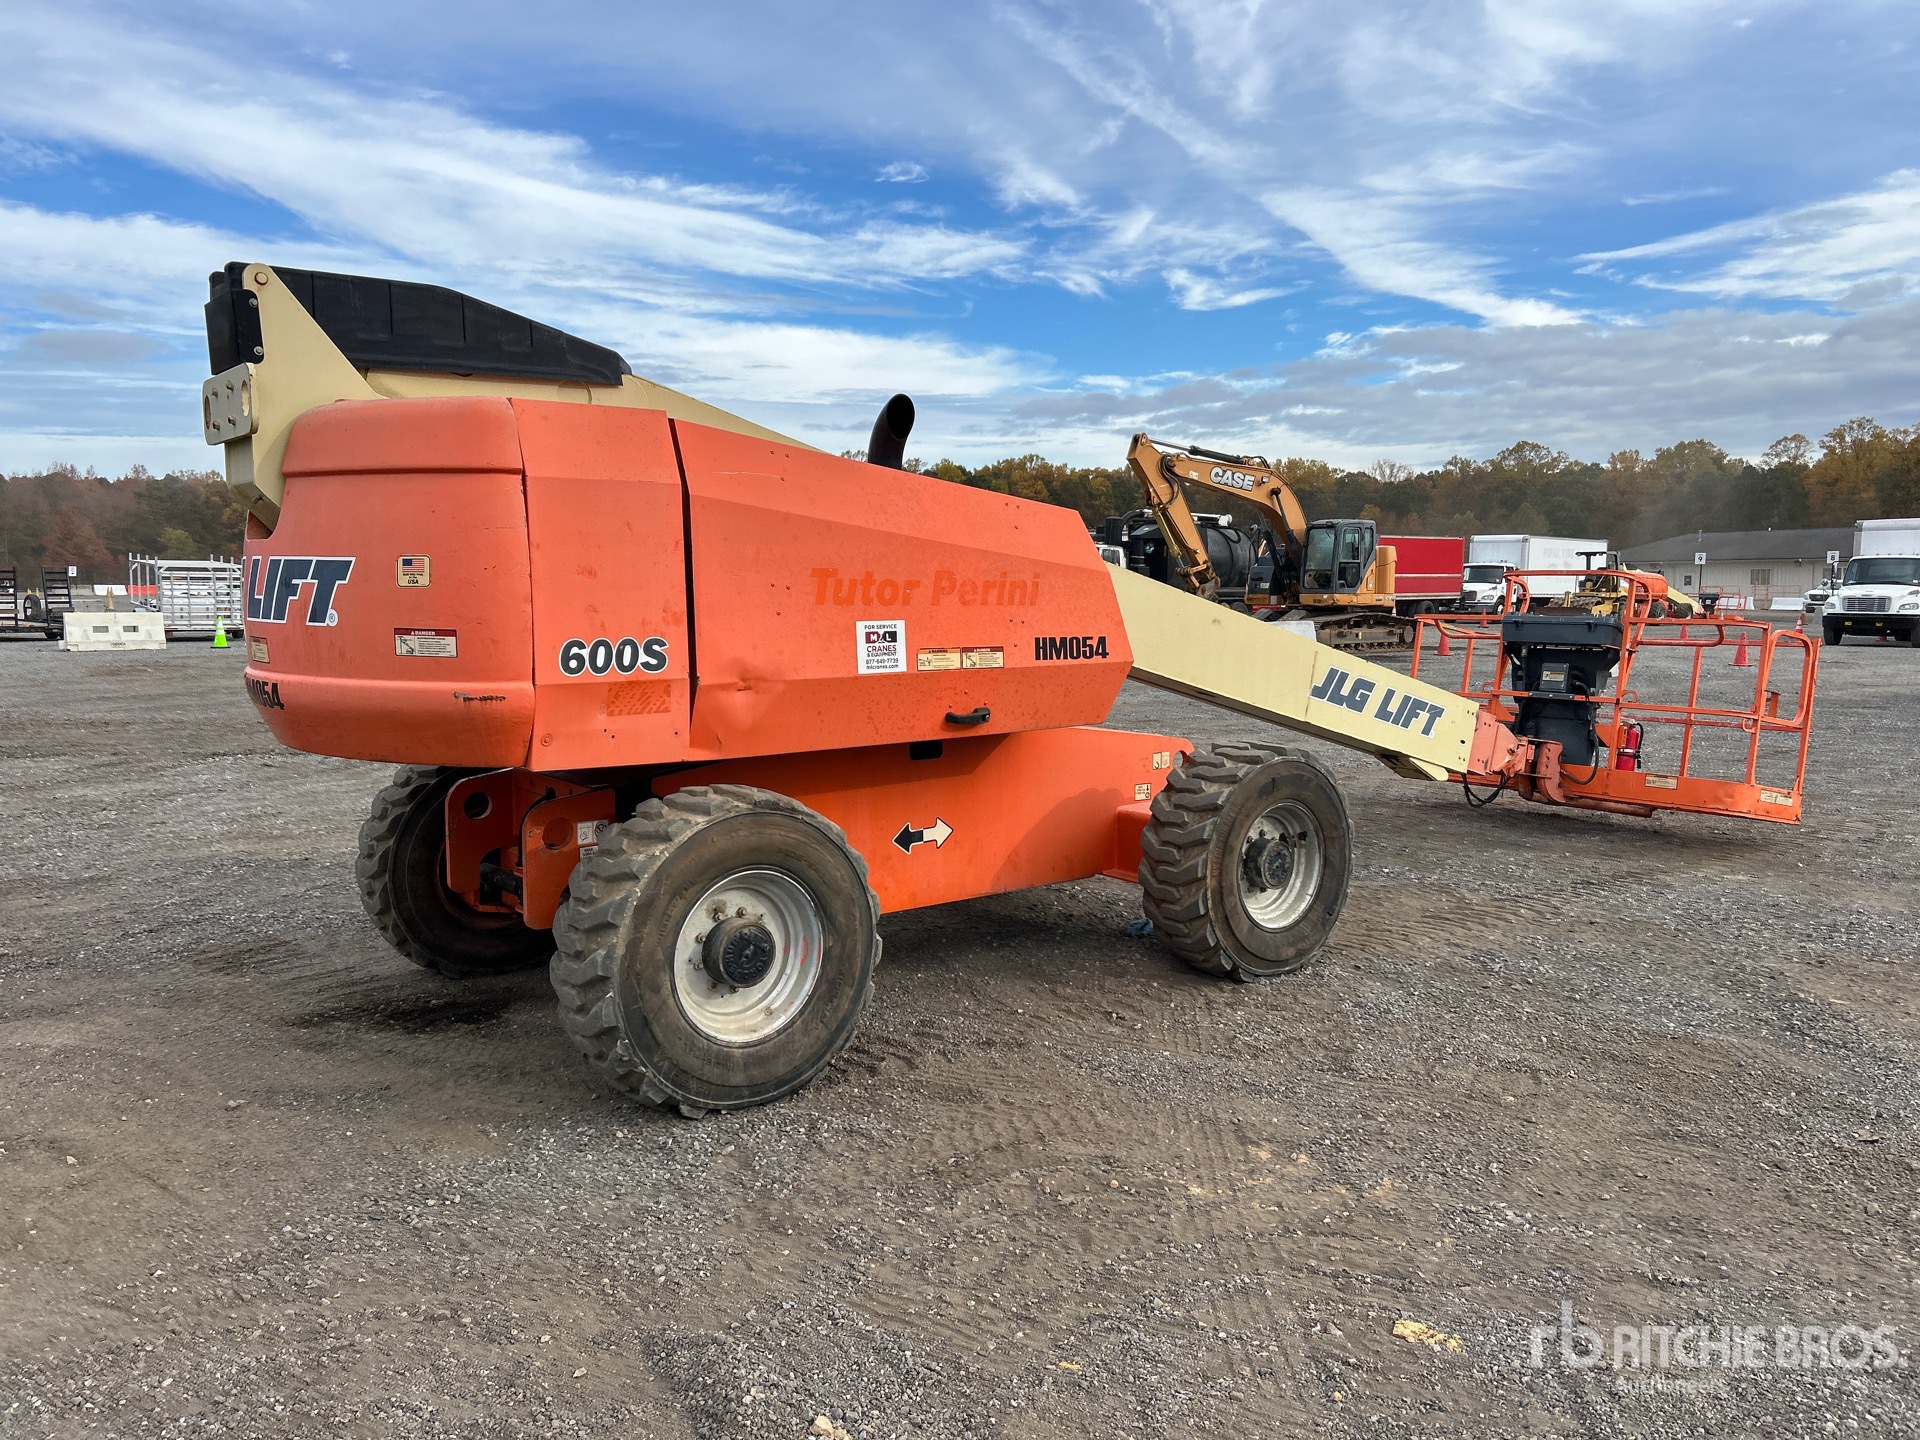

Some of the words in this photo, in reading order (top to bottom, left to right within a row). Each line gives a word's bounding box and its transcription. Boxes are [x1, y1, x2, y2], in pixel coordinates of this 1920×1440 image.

[1210, 465, 1256, 491] CASE
[247, 556, 356, 626] LIFT
[811, 567, 921, 606] Tutor
[930, 570, 1041, 607] Perini
[559, 637, 669, 676] 600S
[866, 645, 897, 653] CRANES
[1034, 636, 1109, 660] HM054
[1307, 666, 1377, 715] JLG
[1373, 687, 1447, 739] LIFT
